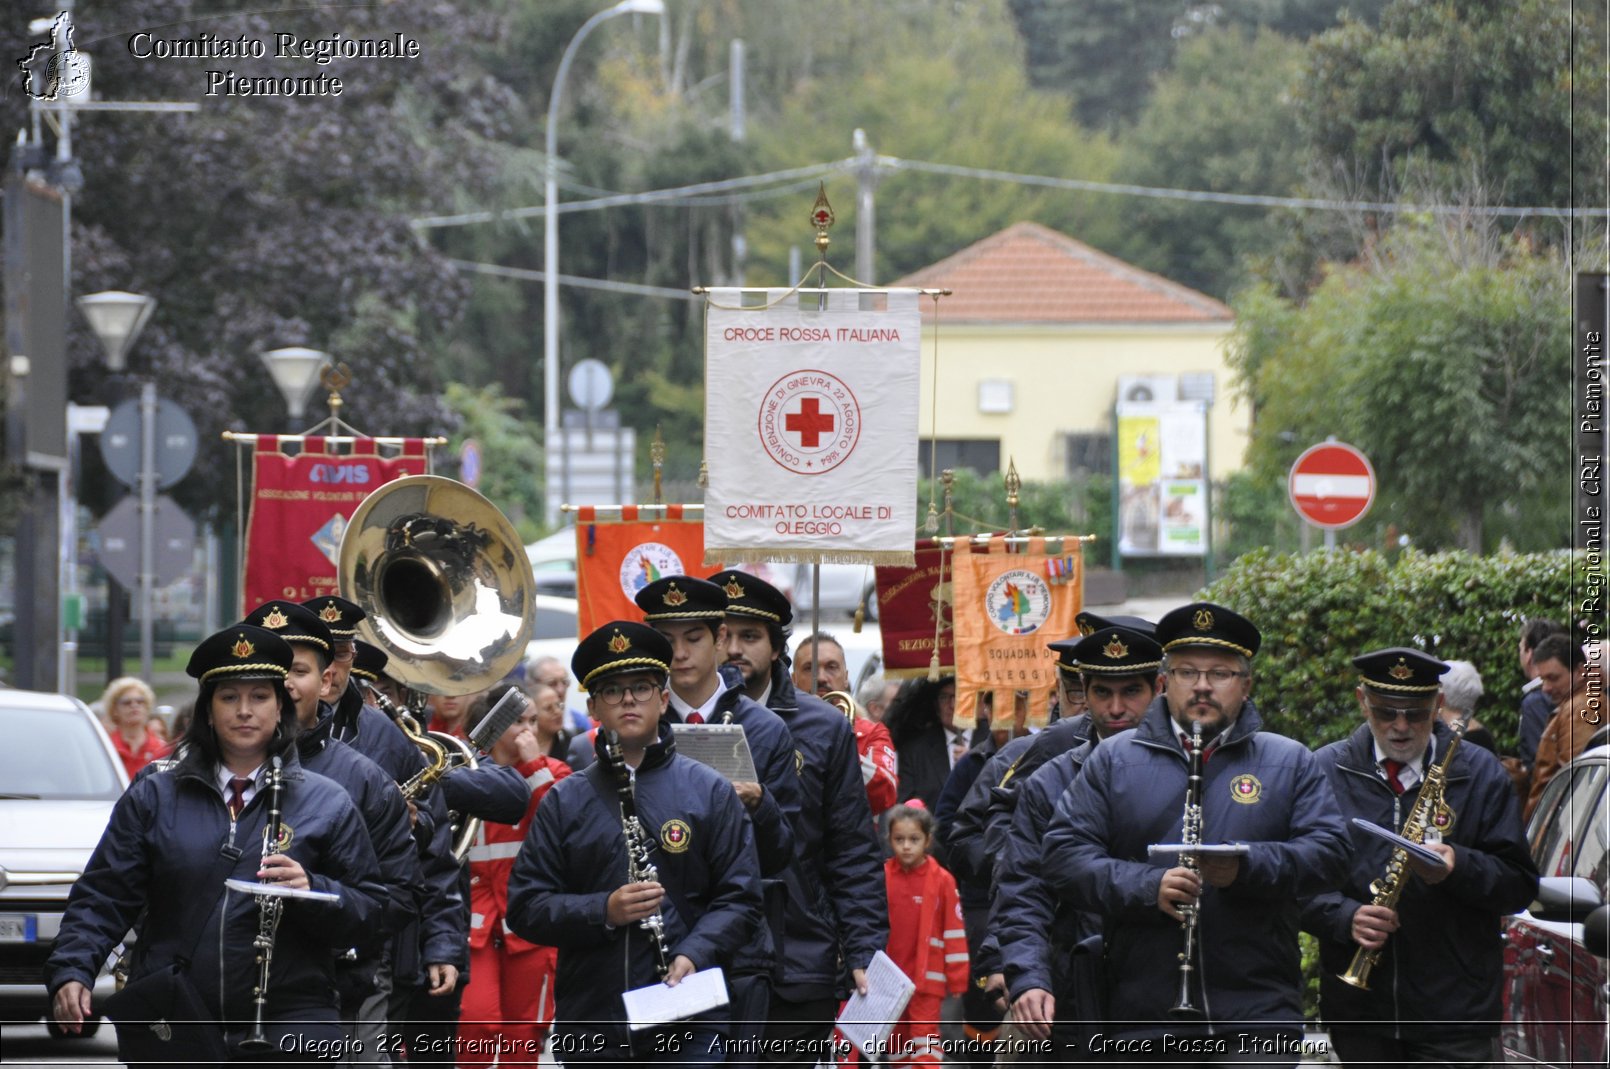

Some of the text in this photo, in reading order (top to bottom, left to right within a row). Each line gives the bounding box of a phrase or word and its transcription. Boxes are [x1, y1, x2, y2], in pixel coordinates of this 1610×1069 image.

[724, 327, 900, 342] CROCE ROSSA ITALIANA
[765, 376, 854, 466] CONVENZIONE DI GINEVRA 22 AGOSTO 1864
[309, 463, 370, 484] AVIS
[725, 505, 891, 519] COMITATO LOCALE DI
[775, 521, 842, 535] OLEGGIO
[988, 648, 1037, 659] SQUADRA
